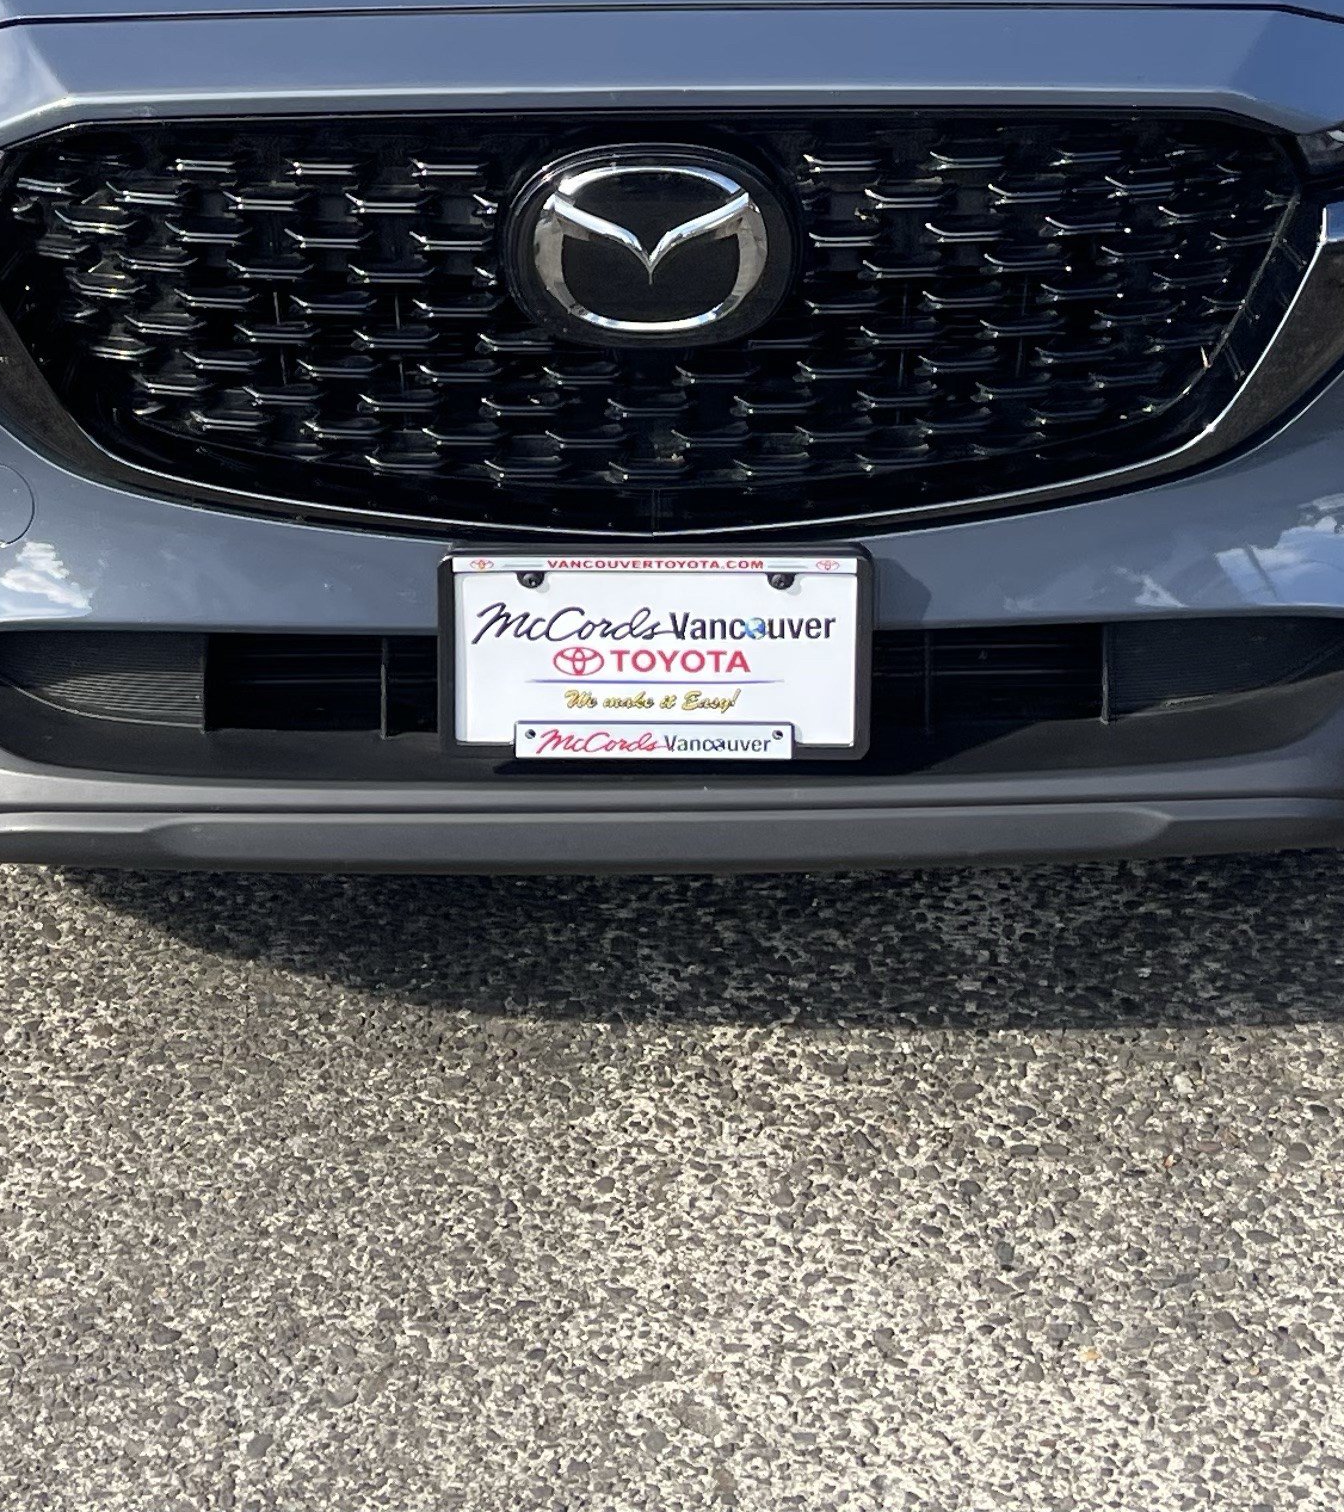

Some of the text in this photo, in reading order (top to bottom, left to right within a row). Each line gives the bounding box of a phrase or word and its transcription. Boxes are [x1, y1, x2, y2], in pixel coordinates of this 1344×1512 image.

[546, 559, 765, 570] VANCOUVERTOYOTA.COM
[471, 601, 837, 645] McCords Vancouver
[610, 649, 751, 673] TOYOTA
[564, 688, 742, 714] We make it Easy!
[535, 728, 772, 755] McCords Vancouver
